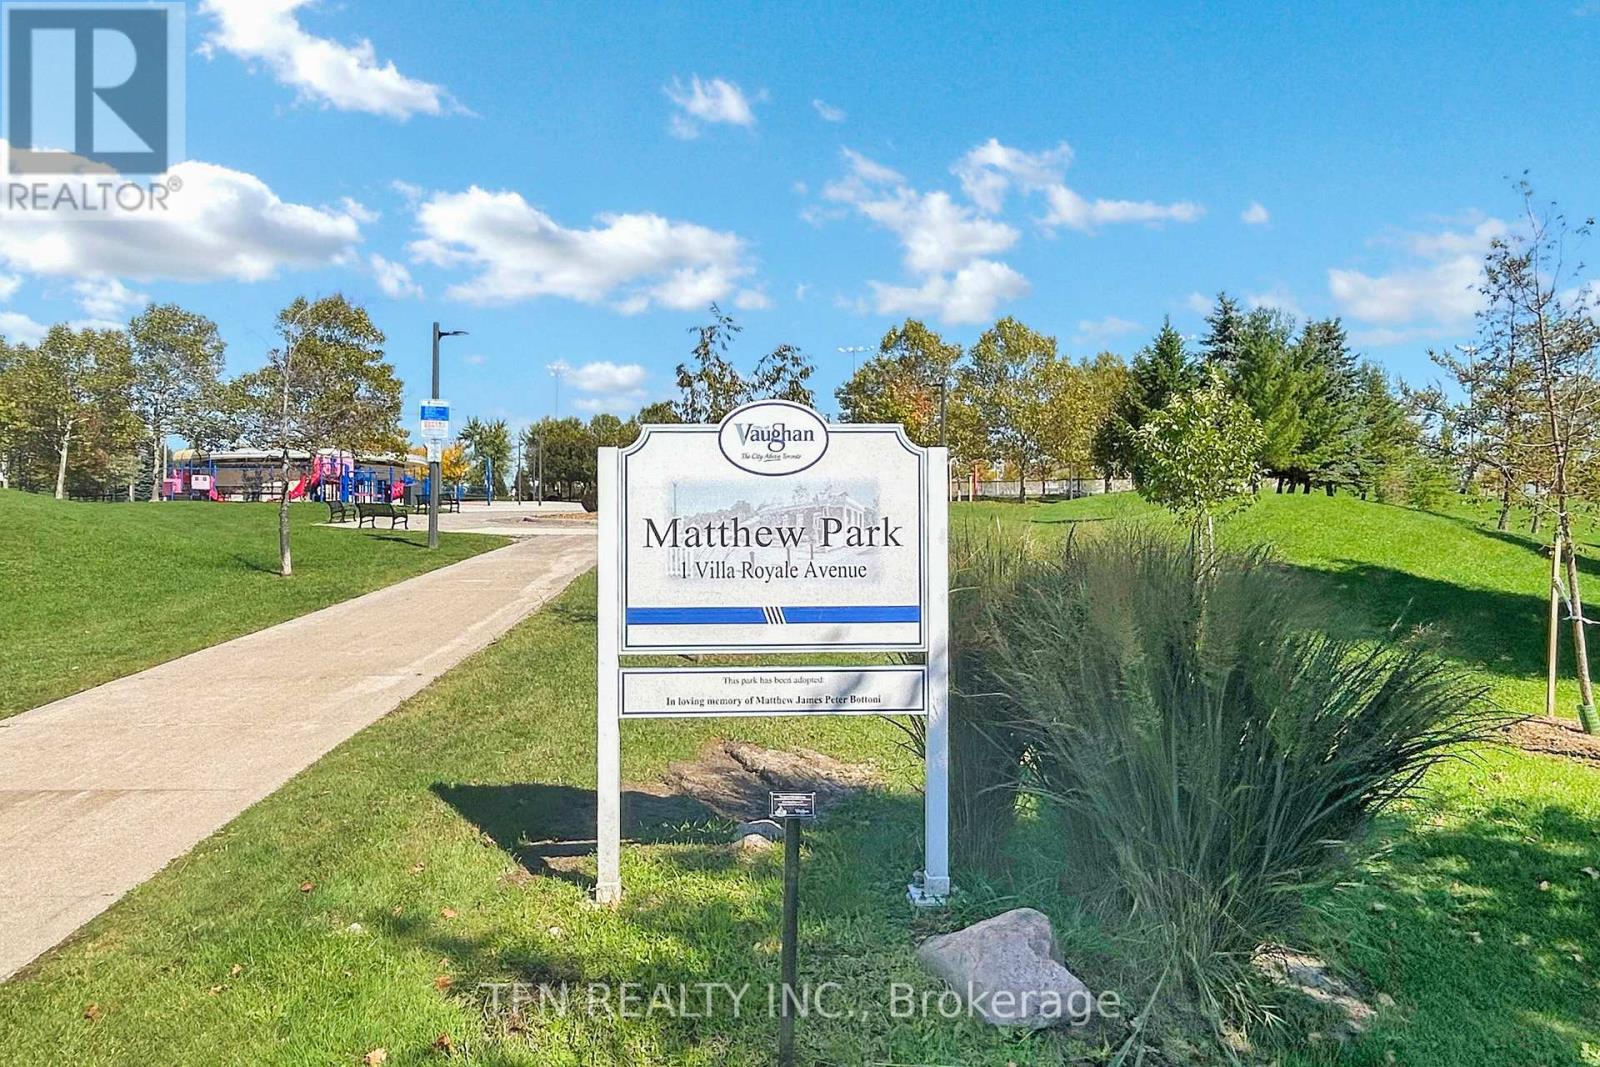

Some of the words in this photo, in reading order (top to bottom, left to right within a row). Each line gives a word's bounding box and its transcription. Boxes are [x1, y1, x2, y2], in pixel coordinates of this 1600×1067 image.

[734, 422, 815, 453] Vaughan
[642, 516, 806, 548] Matthew
[819, 516, 904, 547] Park
[695, 560, 736, 579] Villa
[741, 560, 799, 584] Royale
[804, 561, 867, 578] Avenue
[723, 676, 740, 685] This
[741, 676, 758, 686] park
[759, 676, 773, 684] has
[774, 676, 792, 684] been
[666, 697, 676, 706] In
[678, 697, 705, 707] loving
[707, 698, 742, 707] memory
[744, 696, 755, 705] of
[755, 696, 793, 705] Matthew
[795, 695, 823, 704] James
[825, 695, 849, 704] Peter
[849, 694, 882, 704] Bottoni
